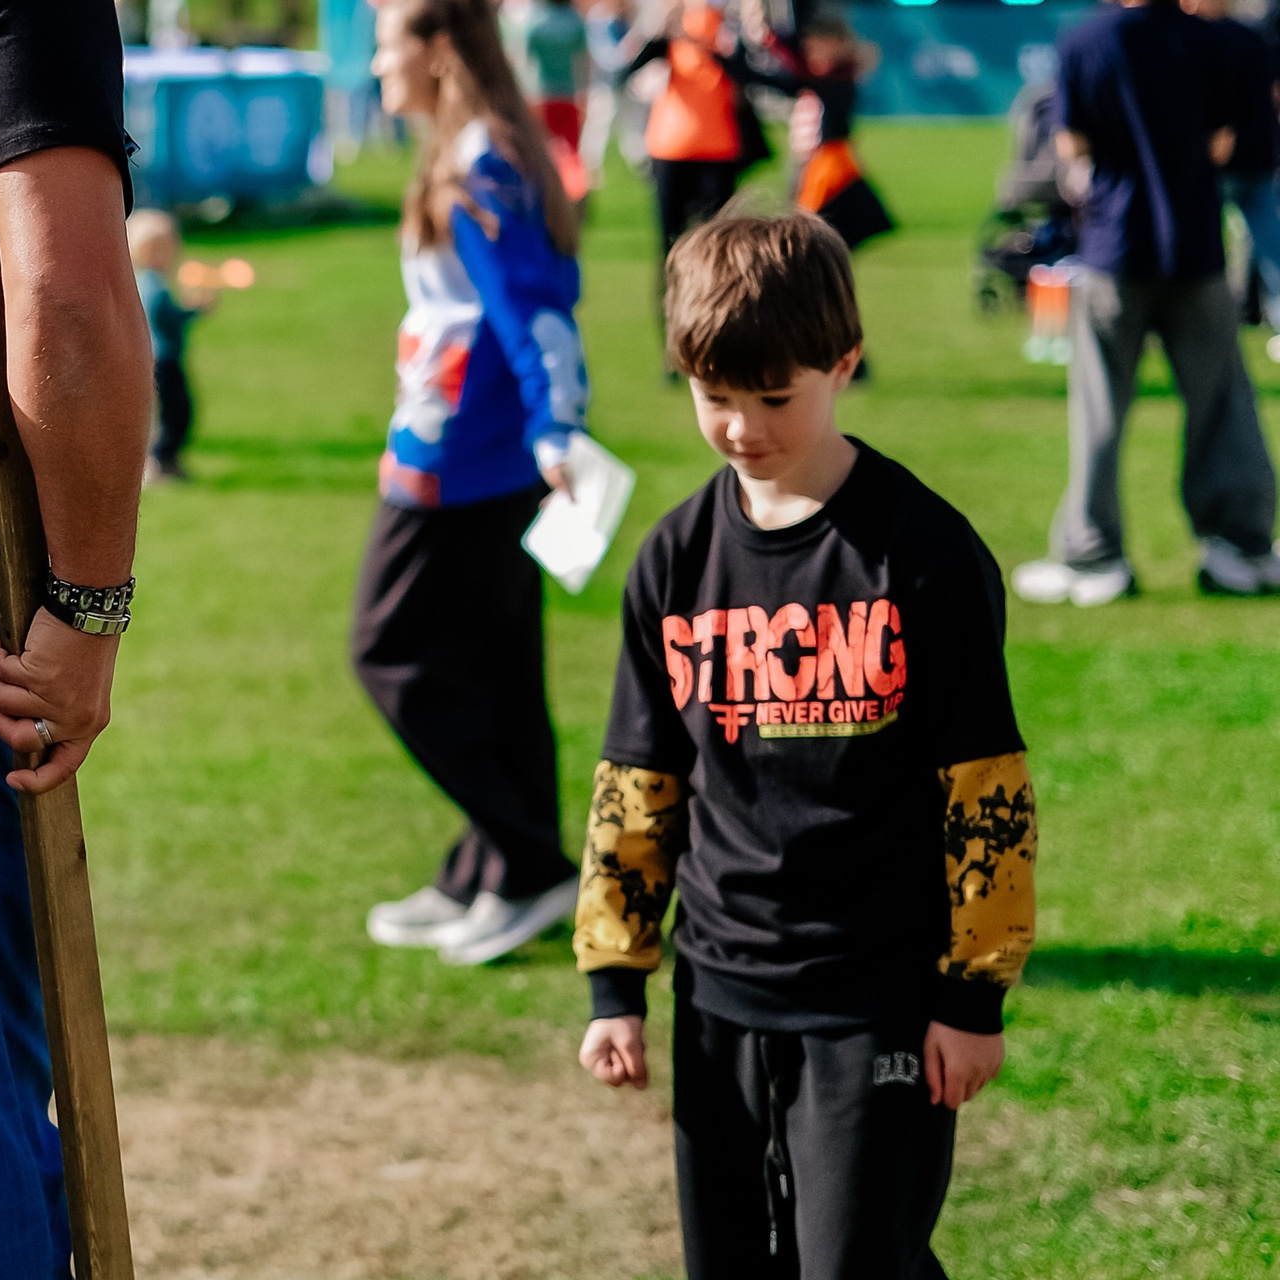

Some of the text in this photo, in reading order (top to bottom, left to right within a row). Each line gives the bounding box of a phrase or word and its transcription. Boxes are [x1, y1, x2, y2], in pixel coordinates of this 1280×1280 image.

[662, 599, 907, 711] STRONG
[755, 692, 904, 726] NEVER GIVE UP
